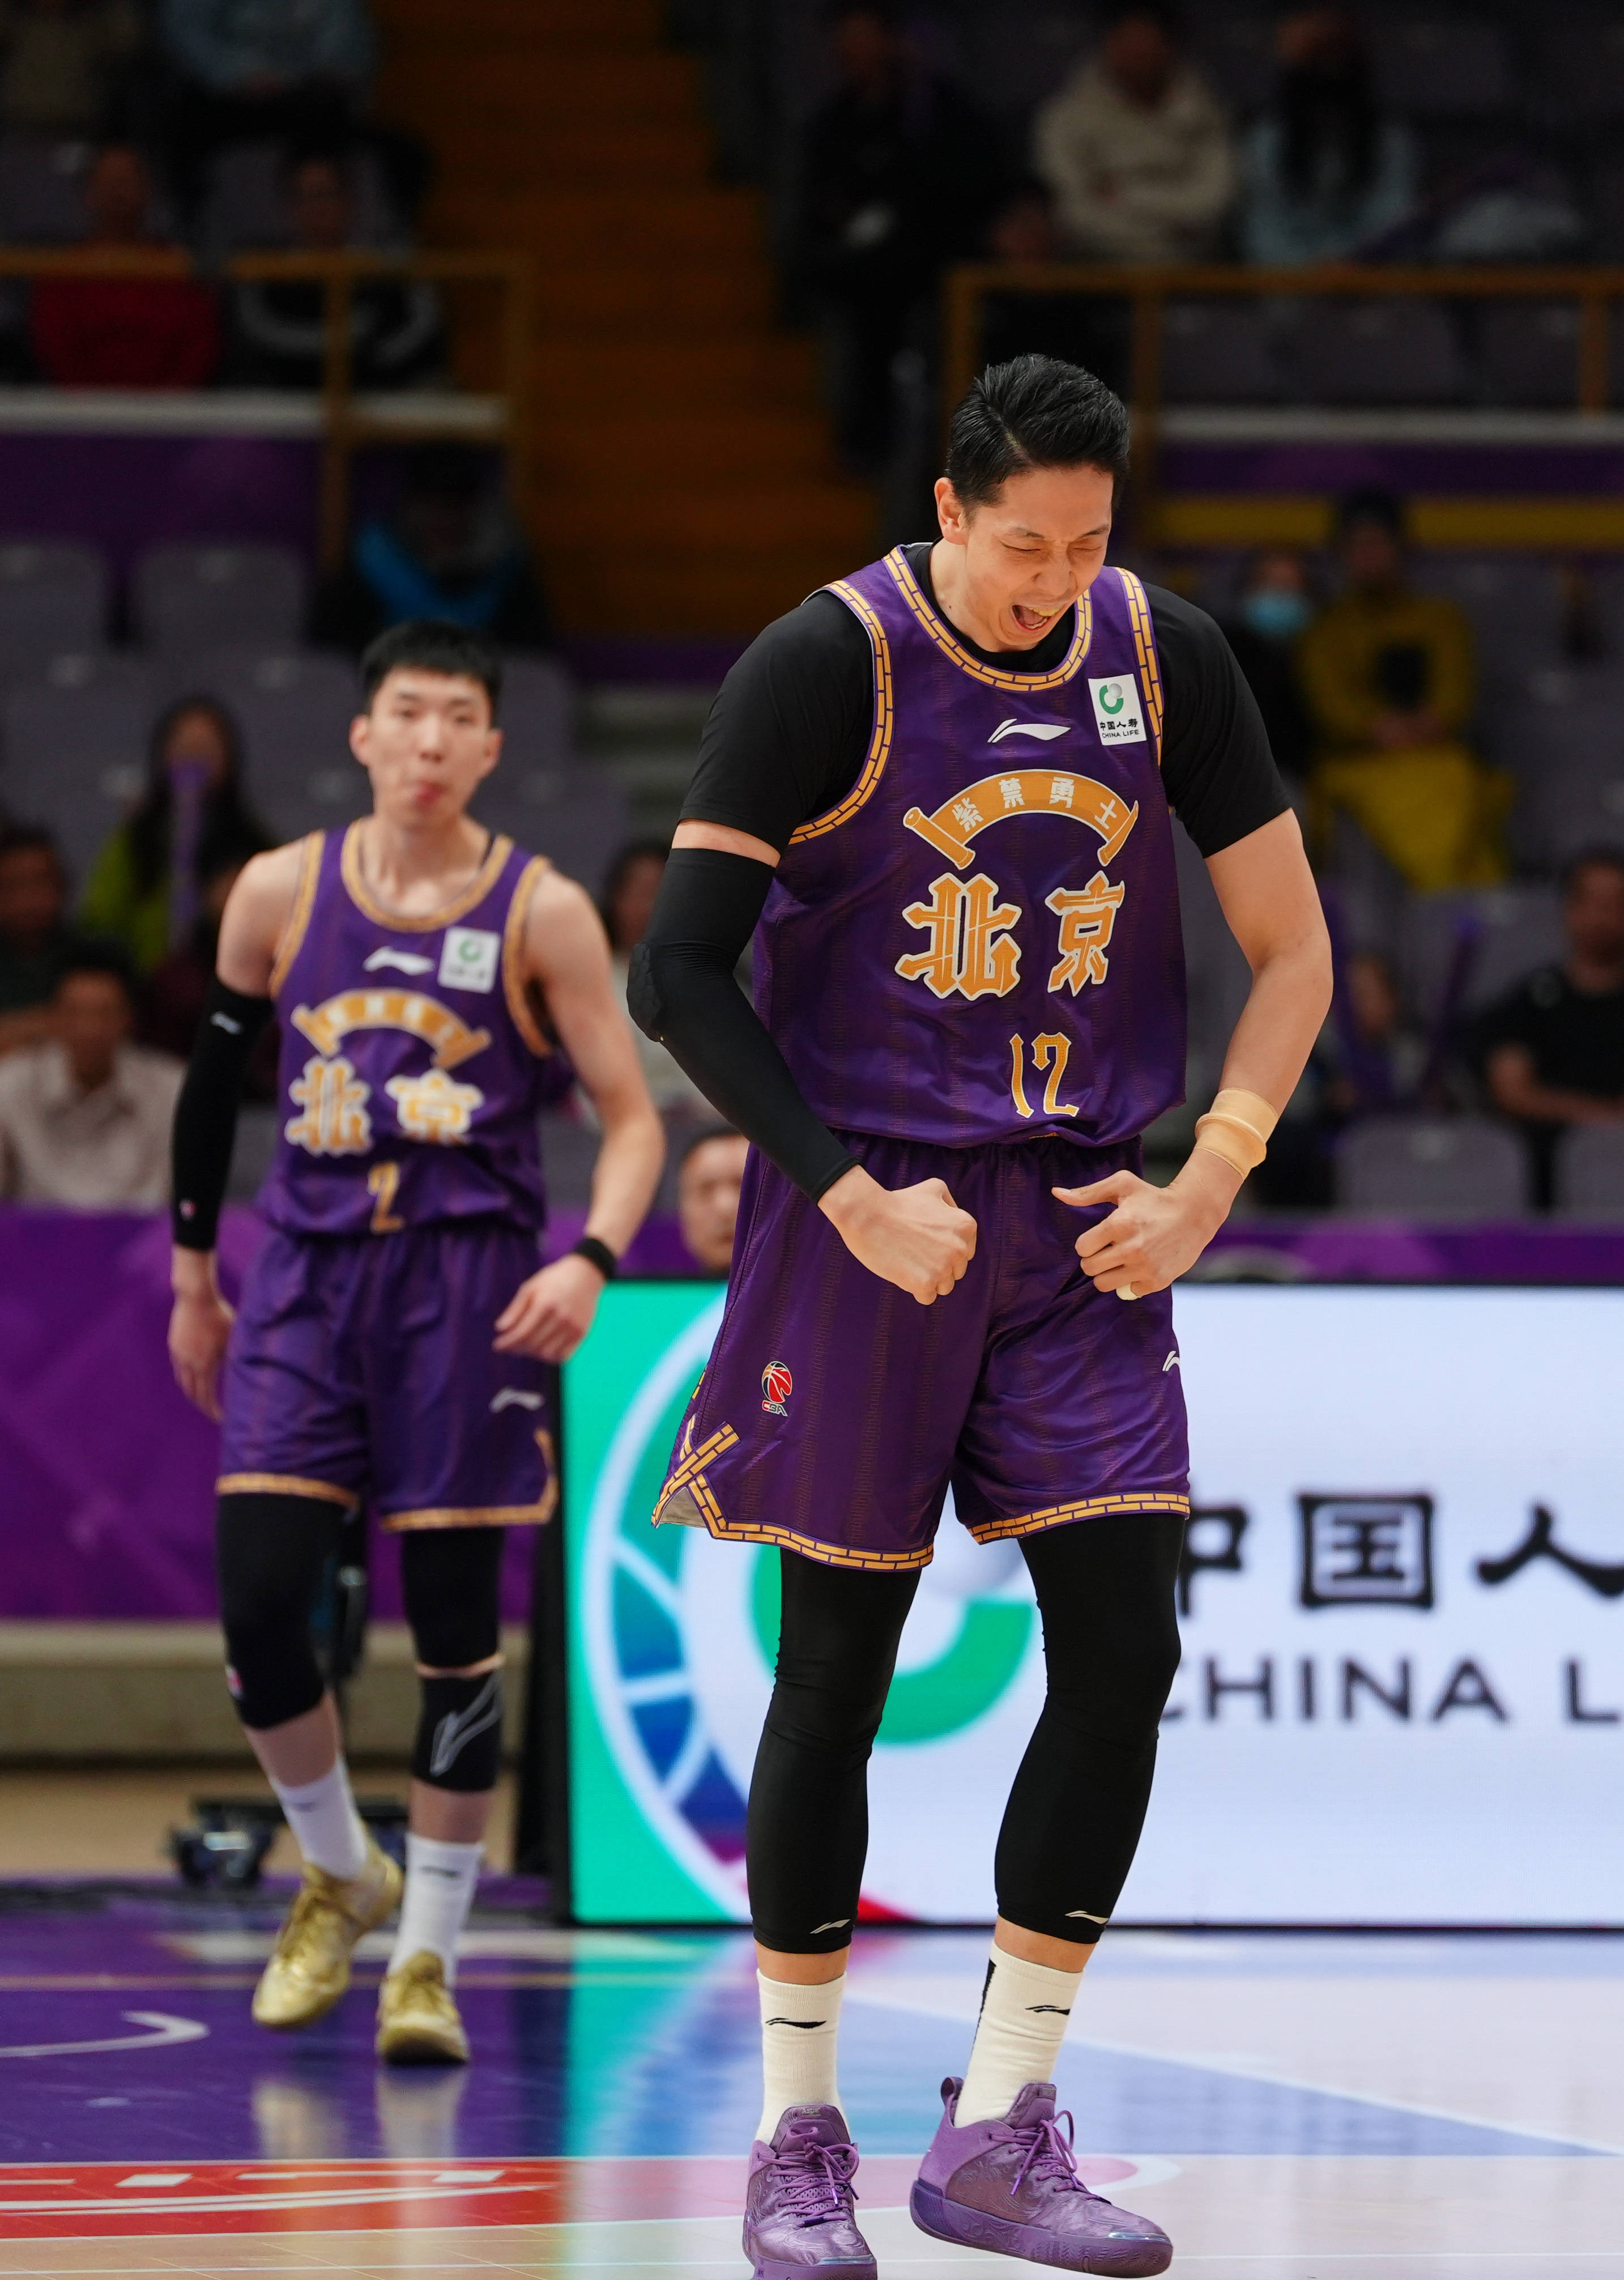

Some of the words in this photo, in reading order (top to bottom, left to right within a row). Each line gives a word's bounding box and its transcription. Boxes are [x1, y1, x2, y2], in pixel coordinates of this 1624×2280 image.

[1099, 718, 1138, 731] 中国人寿
[952, 776, 1117, 832] 紫禁勇士
[895, 870, 1126, 1002] 北京
[285, 1055, 485, 1157] 北京
[1009, 1032, 1080, 1118] 12
[367, 1160, 405, 1234] 2
[762, 1400, 788, 1417] CBA
